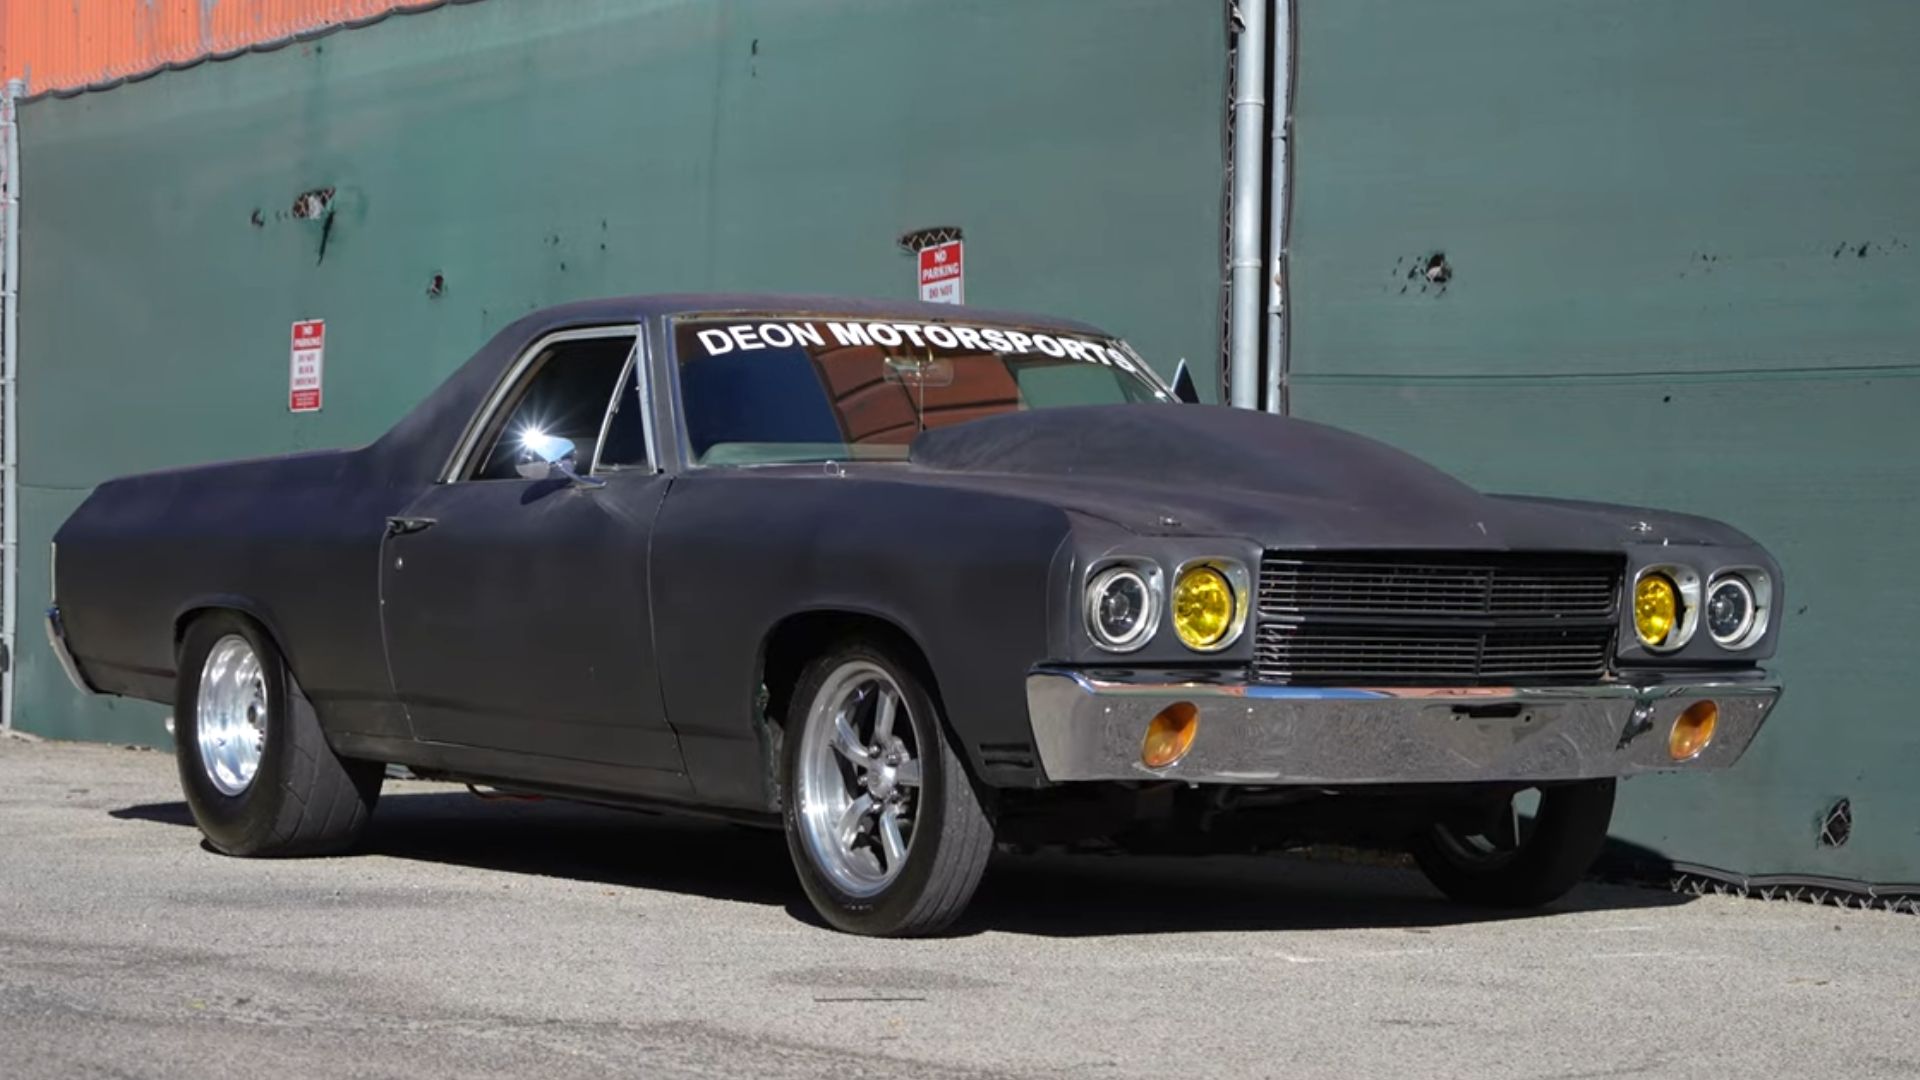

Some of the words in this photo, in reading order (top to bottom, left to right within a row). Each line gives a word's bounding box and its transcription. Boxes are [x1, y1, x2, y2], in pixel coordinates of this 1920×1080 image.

[934, 250, 947, 263] NO
[922, 262, 959, 280] PARKING
[697, 323, 824, 356] DEON
[828, 322, 1136, 373] MOTORSPORTS
